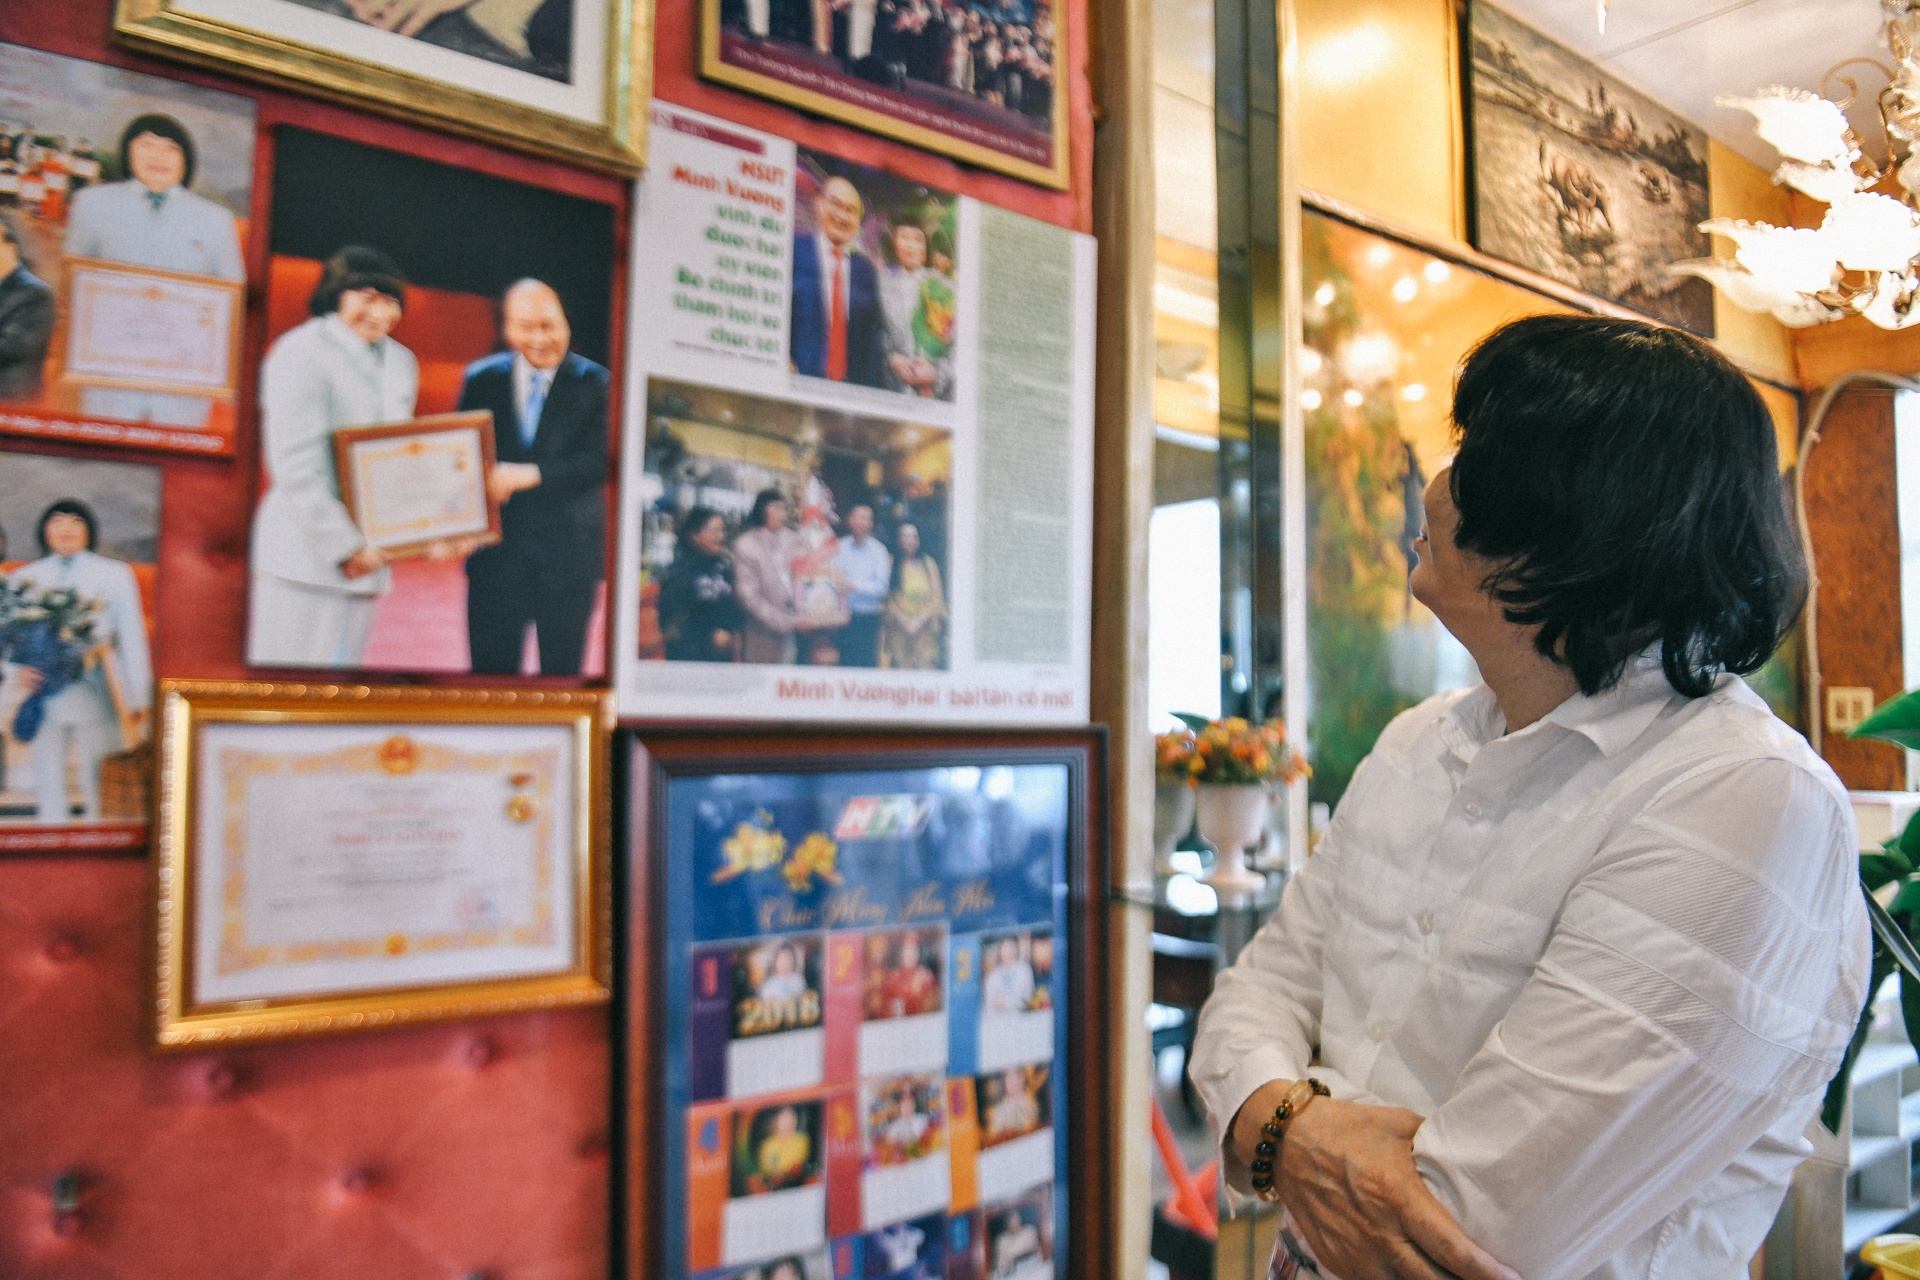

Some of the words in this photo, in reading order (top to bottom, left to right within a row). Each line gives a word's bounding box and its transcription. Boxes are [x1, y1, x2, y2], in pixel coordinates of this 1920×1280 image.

[673, 165, 720, 192] Minh
[777, 678, 834, 700] Minh
[839, 796, 935, 836] HTV
